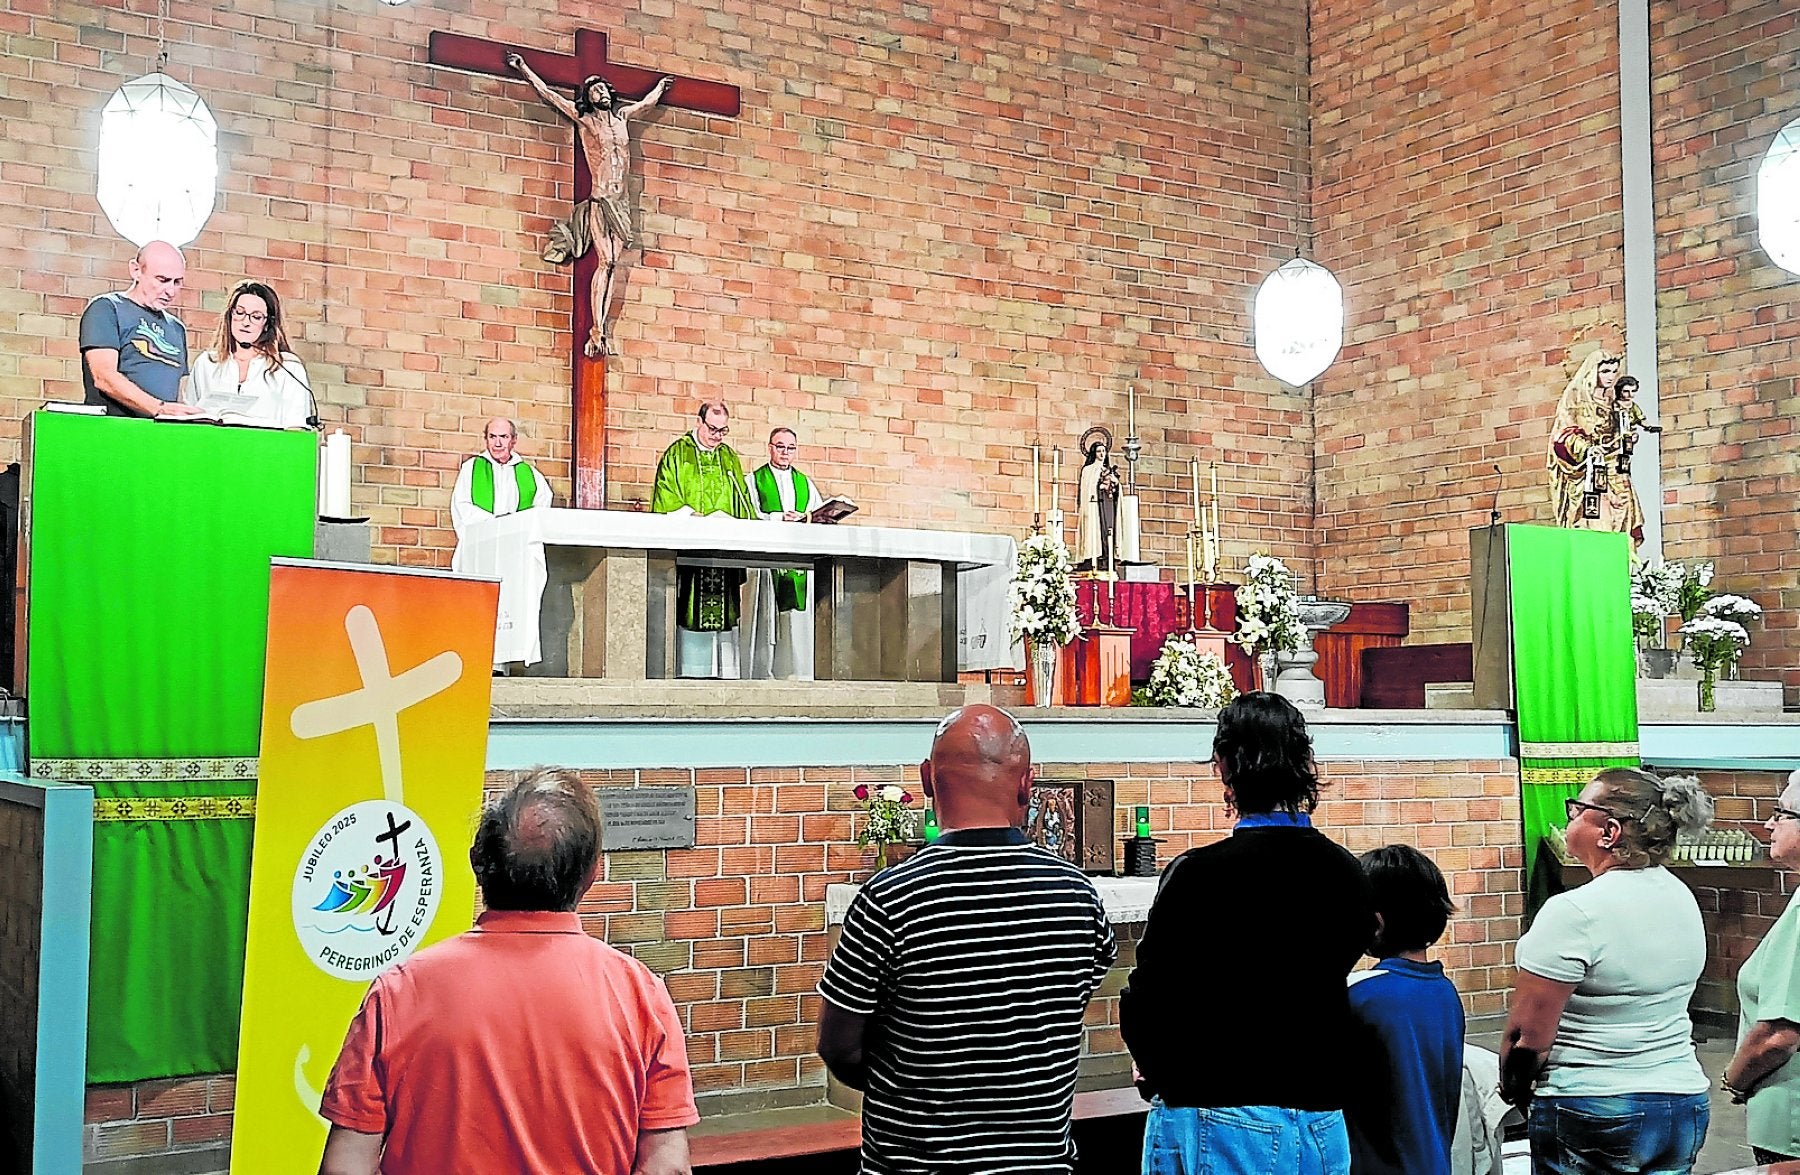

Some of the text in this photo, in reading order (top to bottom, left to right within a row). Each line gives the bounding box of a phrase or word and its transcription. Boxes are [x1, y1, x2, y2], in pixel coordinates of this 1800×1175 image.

[303, 813, 357, 883] JUBILEO 2025
[320, 837, 433, 970] PEREGRINOS DE ESPERANZA
